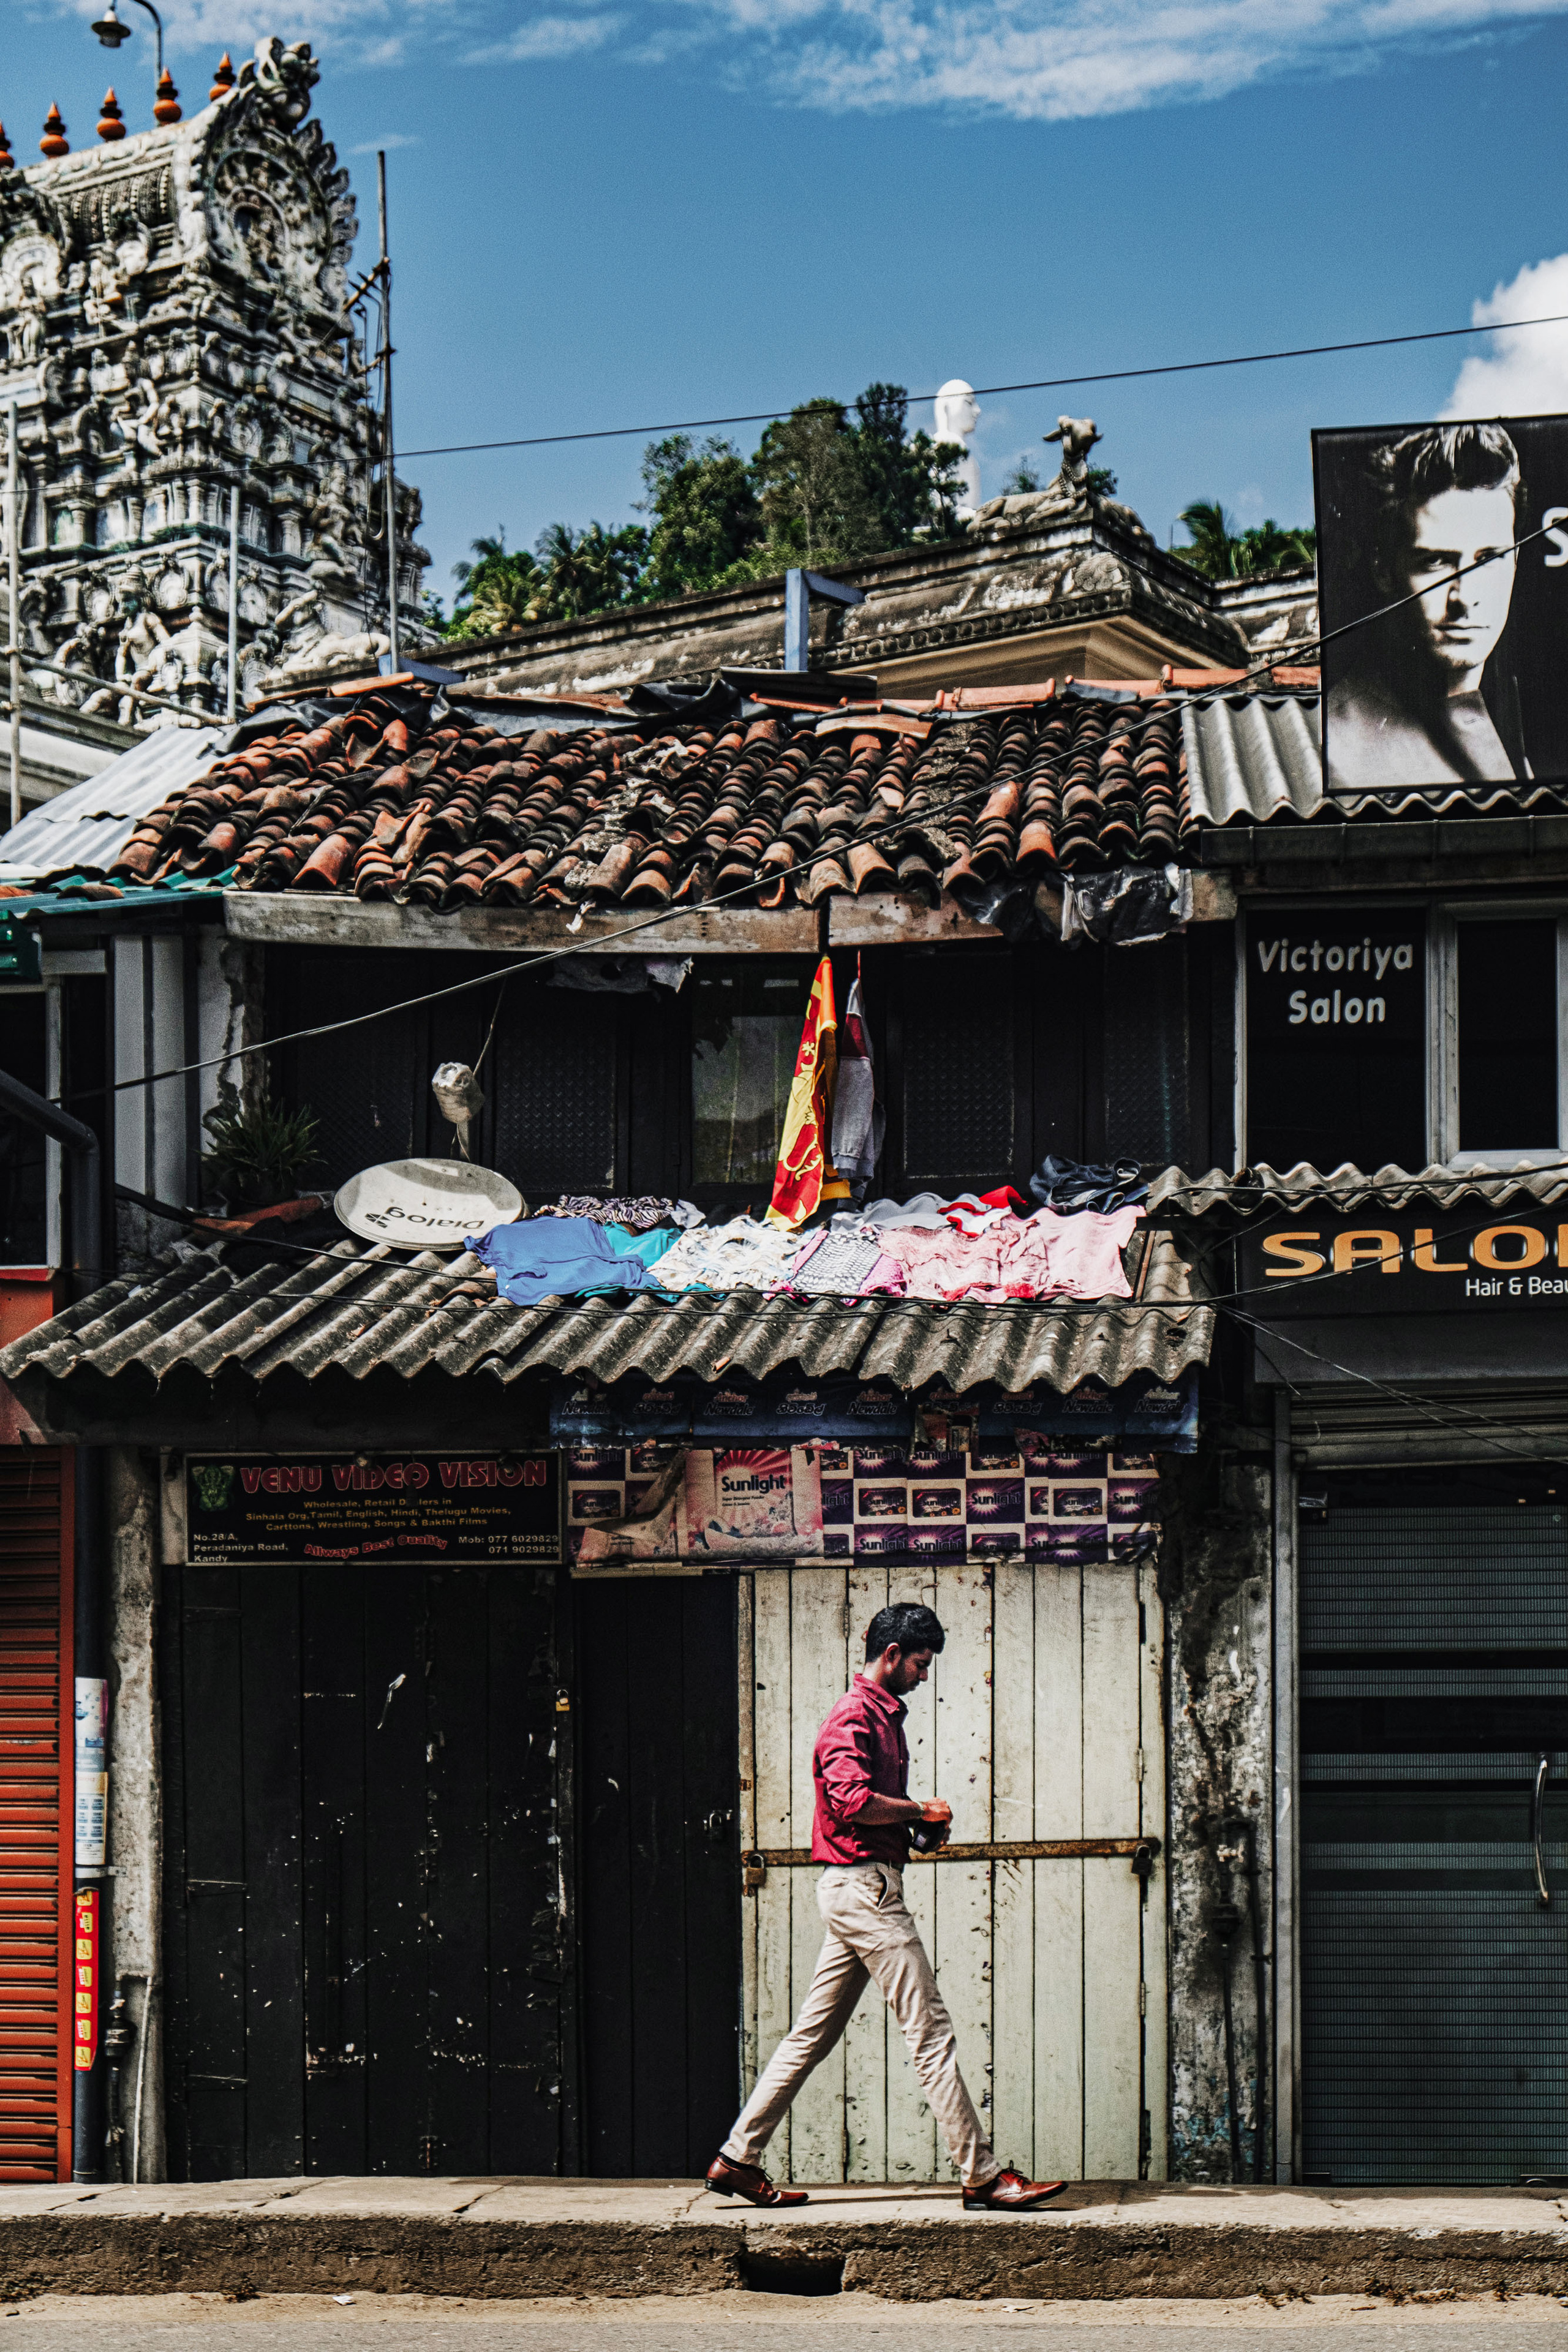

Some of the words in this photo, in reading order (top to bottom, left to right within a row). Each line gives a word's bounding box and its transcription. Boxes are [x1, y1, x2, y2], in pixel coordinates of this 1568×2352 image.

[1258, 937, 1413, 980] Victoriya
[1289, 989, 1385, 1023] Salon
[385, 1206, 484, 1229] Dialog
[1466, 1278, 1504, 1297] Hair
[1508, 1276, 1523, 1295] &
[714, 1390, 748, 1403] Anchor
[856, 1390, 892, 1402] Anchor
[703, 1401, 755, 1415] Newdale
[847, 1401, 898, 1415] Newdale
[1062, 1400, 1115, 1414] Newdale
[241, 1466, 322, 1493] VENU
[331, 1462, 429, 1491] VIDEO
[438, 1460, 547, 1488] VISION
[722, 1474, 785, 1494] Sunlight
[303, 1499, 361, 1509] Wholesale,
[364, 1498, 395, 1507] Retail
[971, 1491, 1021, 1507] Sunlight
[246, 1512, 285, 1521] Sinhala
[345, 1509, 387, 1519] English,
[391, 1509, 421, 1517] Hindi,
[424, 1508, 467, 1517] Thelugu
[470, 1507, 511, 1515] Movies,
[317, 1520, 371, 1530] Wrestling,
[374, 1519, 406, 1529] Songs
[361, 1536, 395, 1554] Best
[397, 1534, 448, 1550] Quality
[488, 1535, 508, 1544] 077
[511, 1534, 559, 1543] 6029829
[913, 1538, 962, 1552] Sunlight
[194, 1544, 254, 1553] Peradaniya
[257, 1543, 289, 1551] Road,
[488, 1545, 508, 1554] 071
[512, 1545, 559, 1554] 9029829
